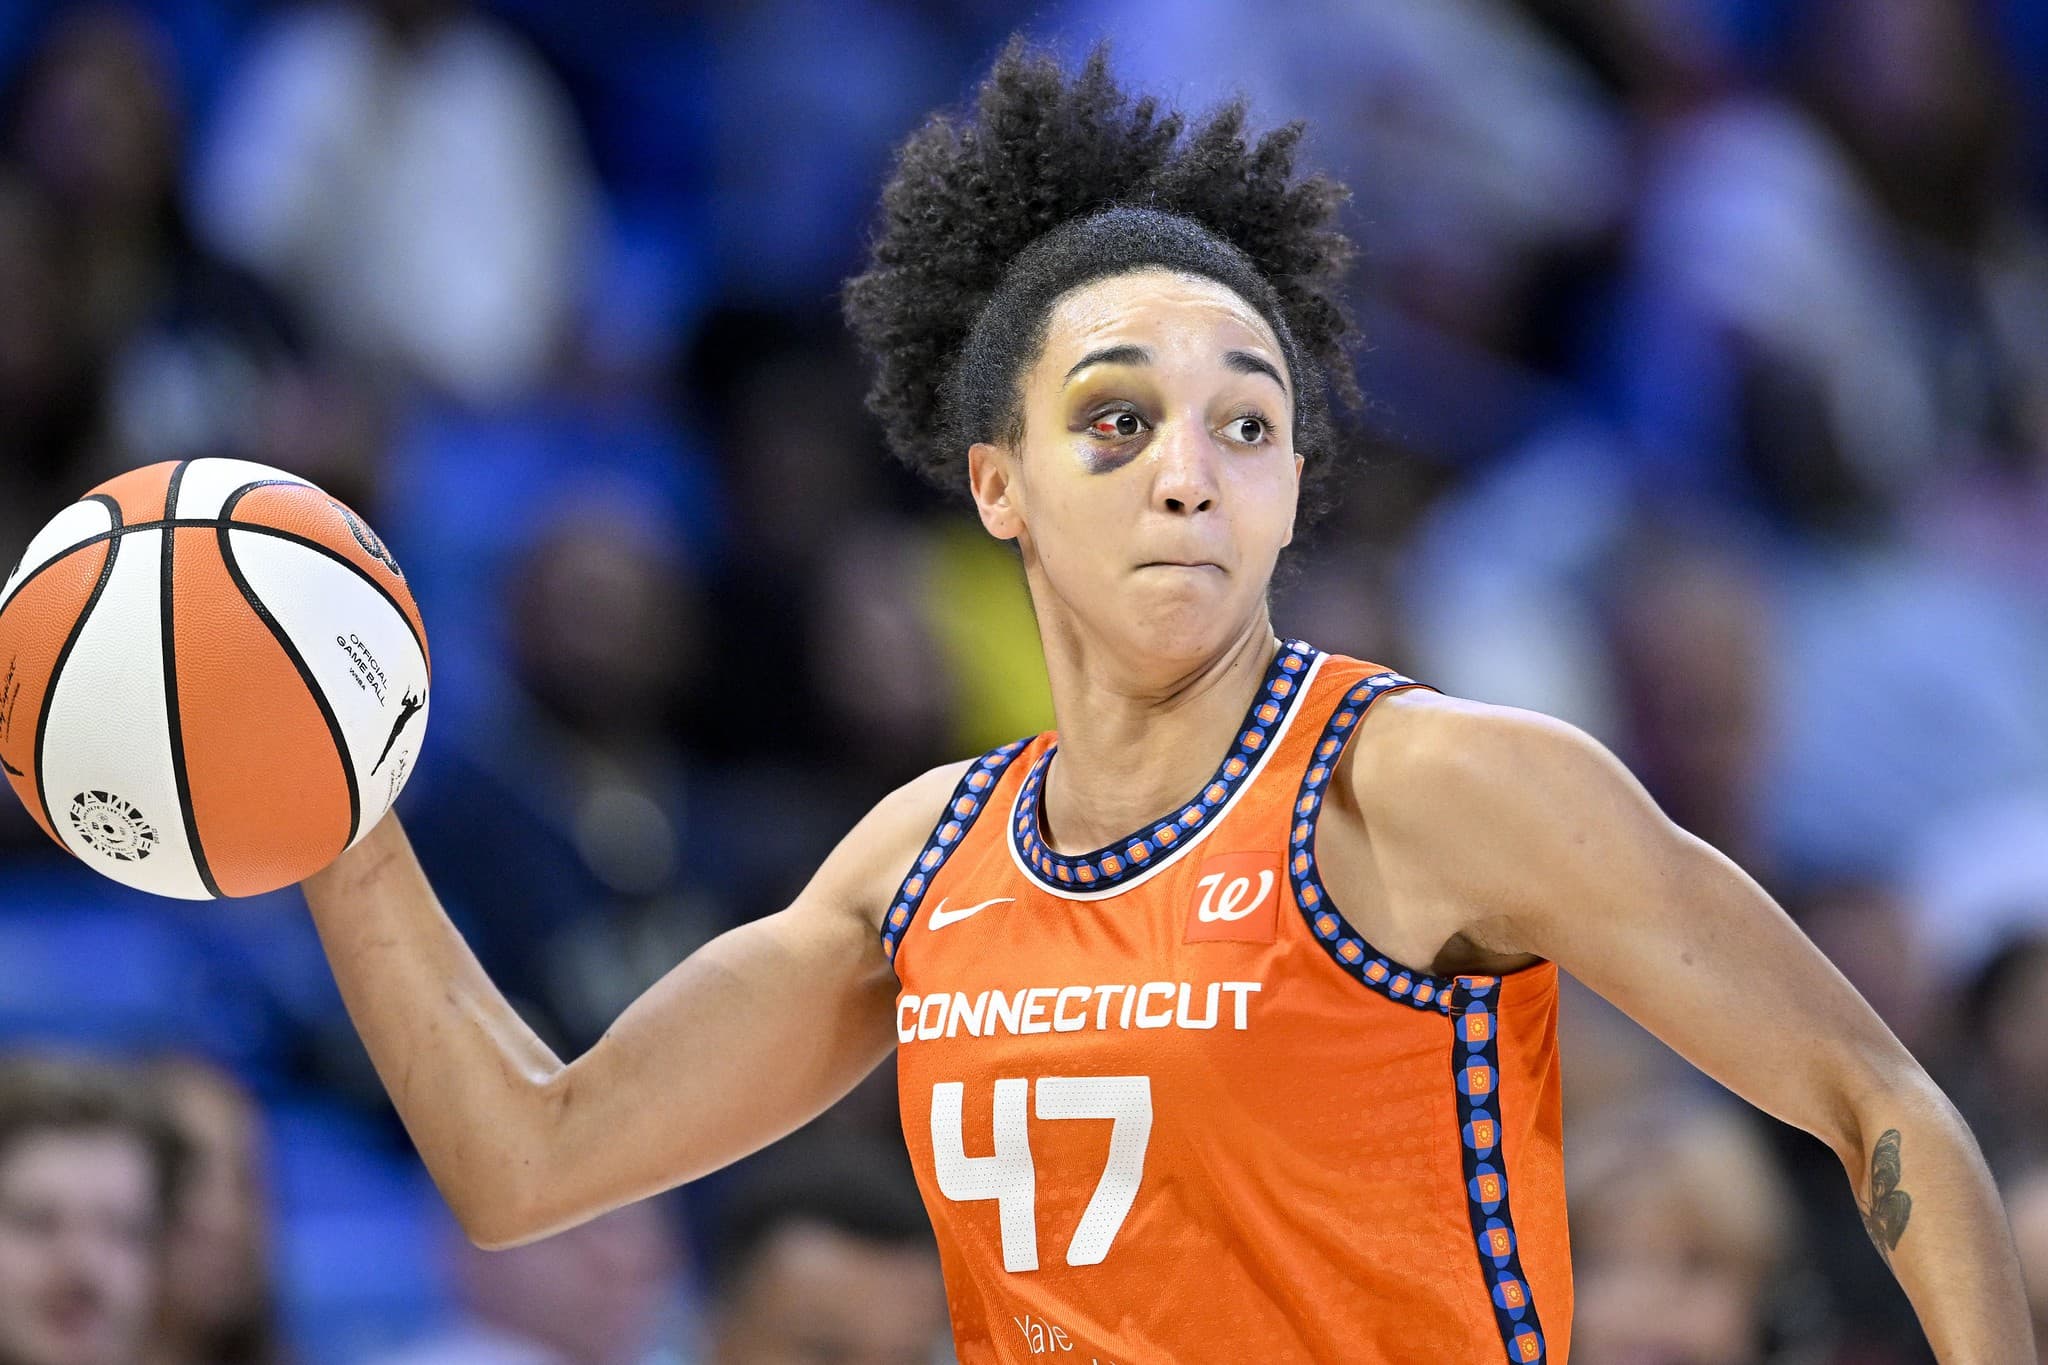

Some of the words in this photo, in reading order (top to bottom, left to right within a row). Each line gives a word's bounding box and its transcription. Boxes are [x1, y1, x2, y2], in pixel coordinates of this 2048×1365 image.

[336, 635, 367, 673] GAME
[366, 671, 386, 708] BALL
[349, 667, 366, 691] WNBA
[350, 633, 388, 690] OFFICIAL
[896, 981, 1262, 1044] CONNECTICUT
[931, 1075, 1153, 1273] 47
[1013, 1314, 1074, 1354] Yale
